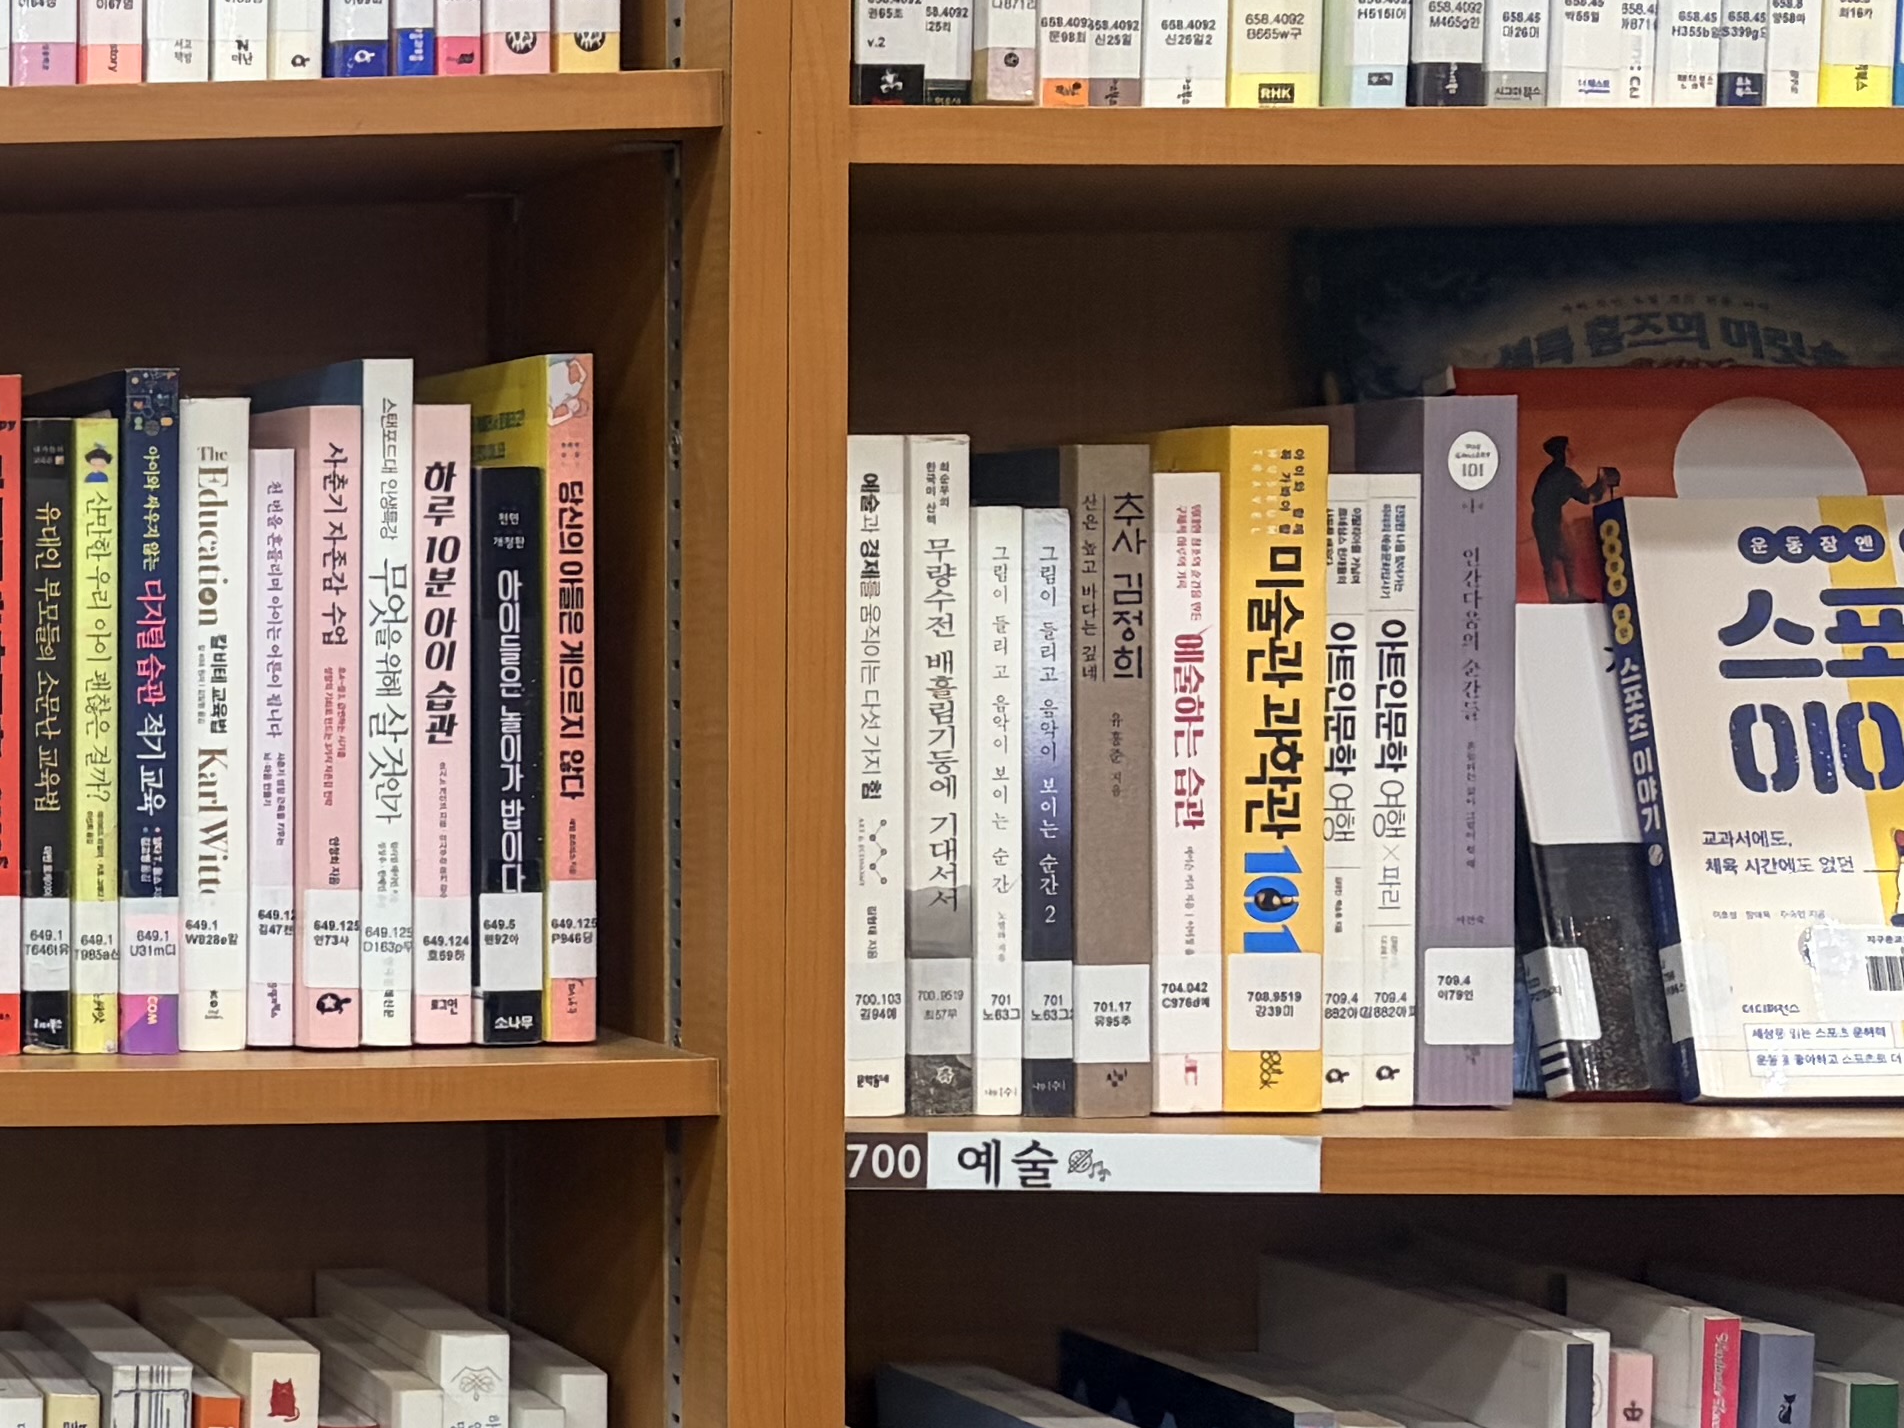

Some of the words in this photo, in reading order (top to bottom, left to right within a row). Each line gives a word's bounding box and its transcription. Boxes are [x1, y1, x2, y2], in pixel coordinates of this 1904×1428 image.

[201, 447, 227, 461] The
[424, 462, 456, 526] 하루
[1112, 492, 1147, 554] 추사
[198, 467, 228, 625] Education
[425, 536, 460, 597] 10분
[425, 608, 456, 671] 아이
[1113, 573, 1143, 678] 김정희
[1247, 547, 1304, 688] 미술관
[426, 681, 458, 744] 습관
[1245, 694, 1303, 839] 과학관
[1239, 846, 1303, 952] 101
[1094, 1002, 1131, 1012] 701.17
[847, 1144, 921, 1179] 700
[958, 1139, 1058, 1188] 예술
